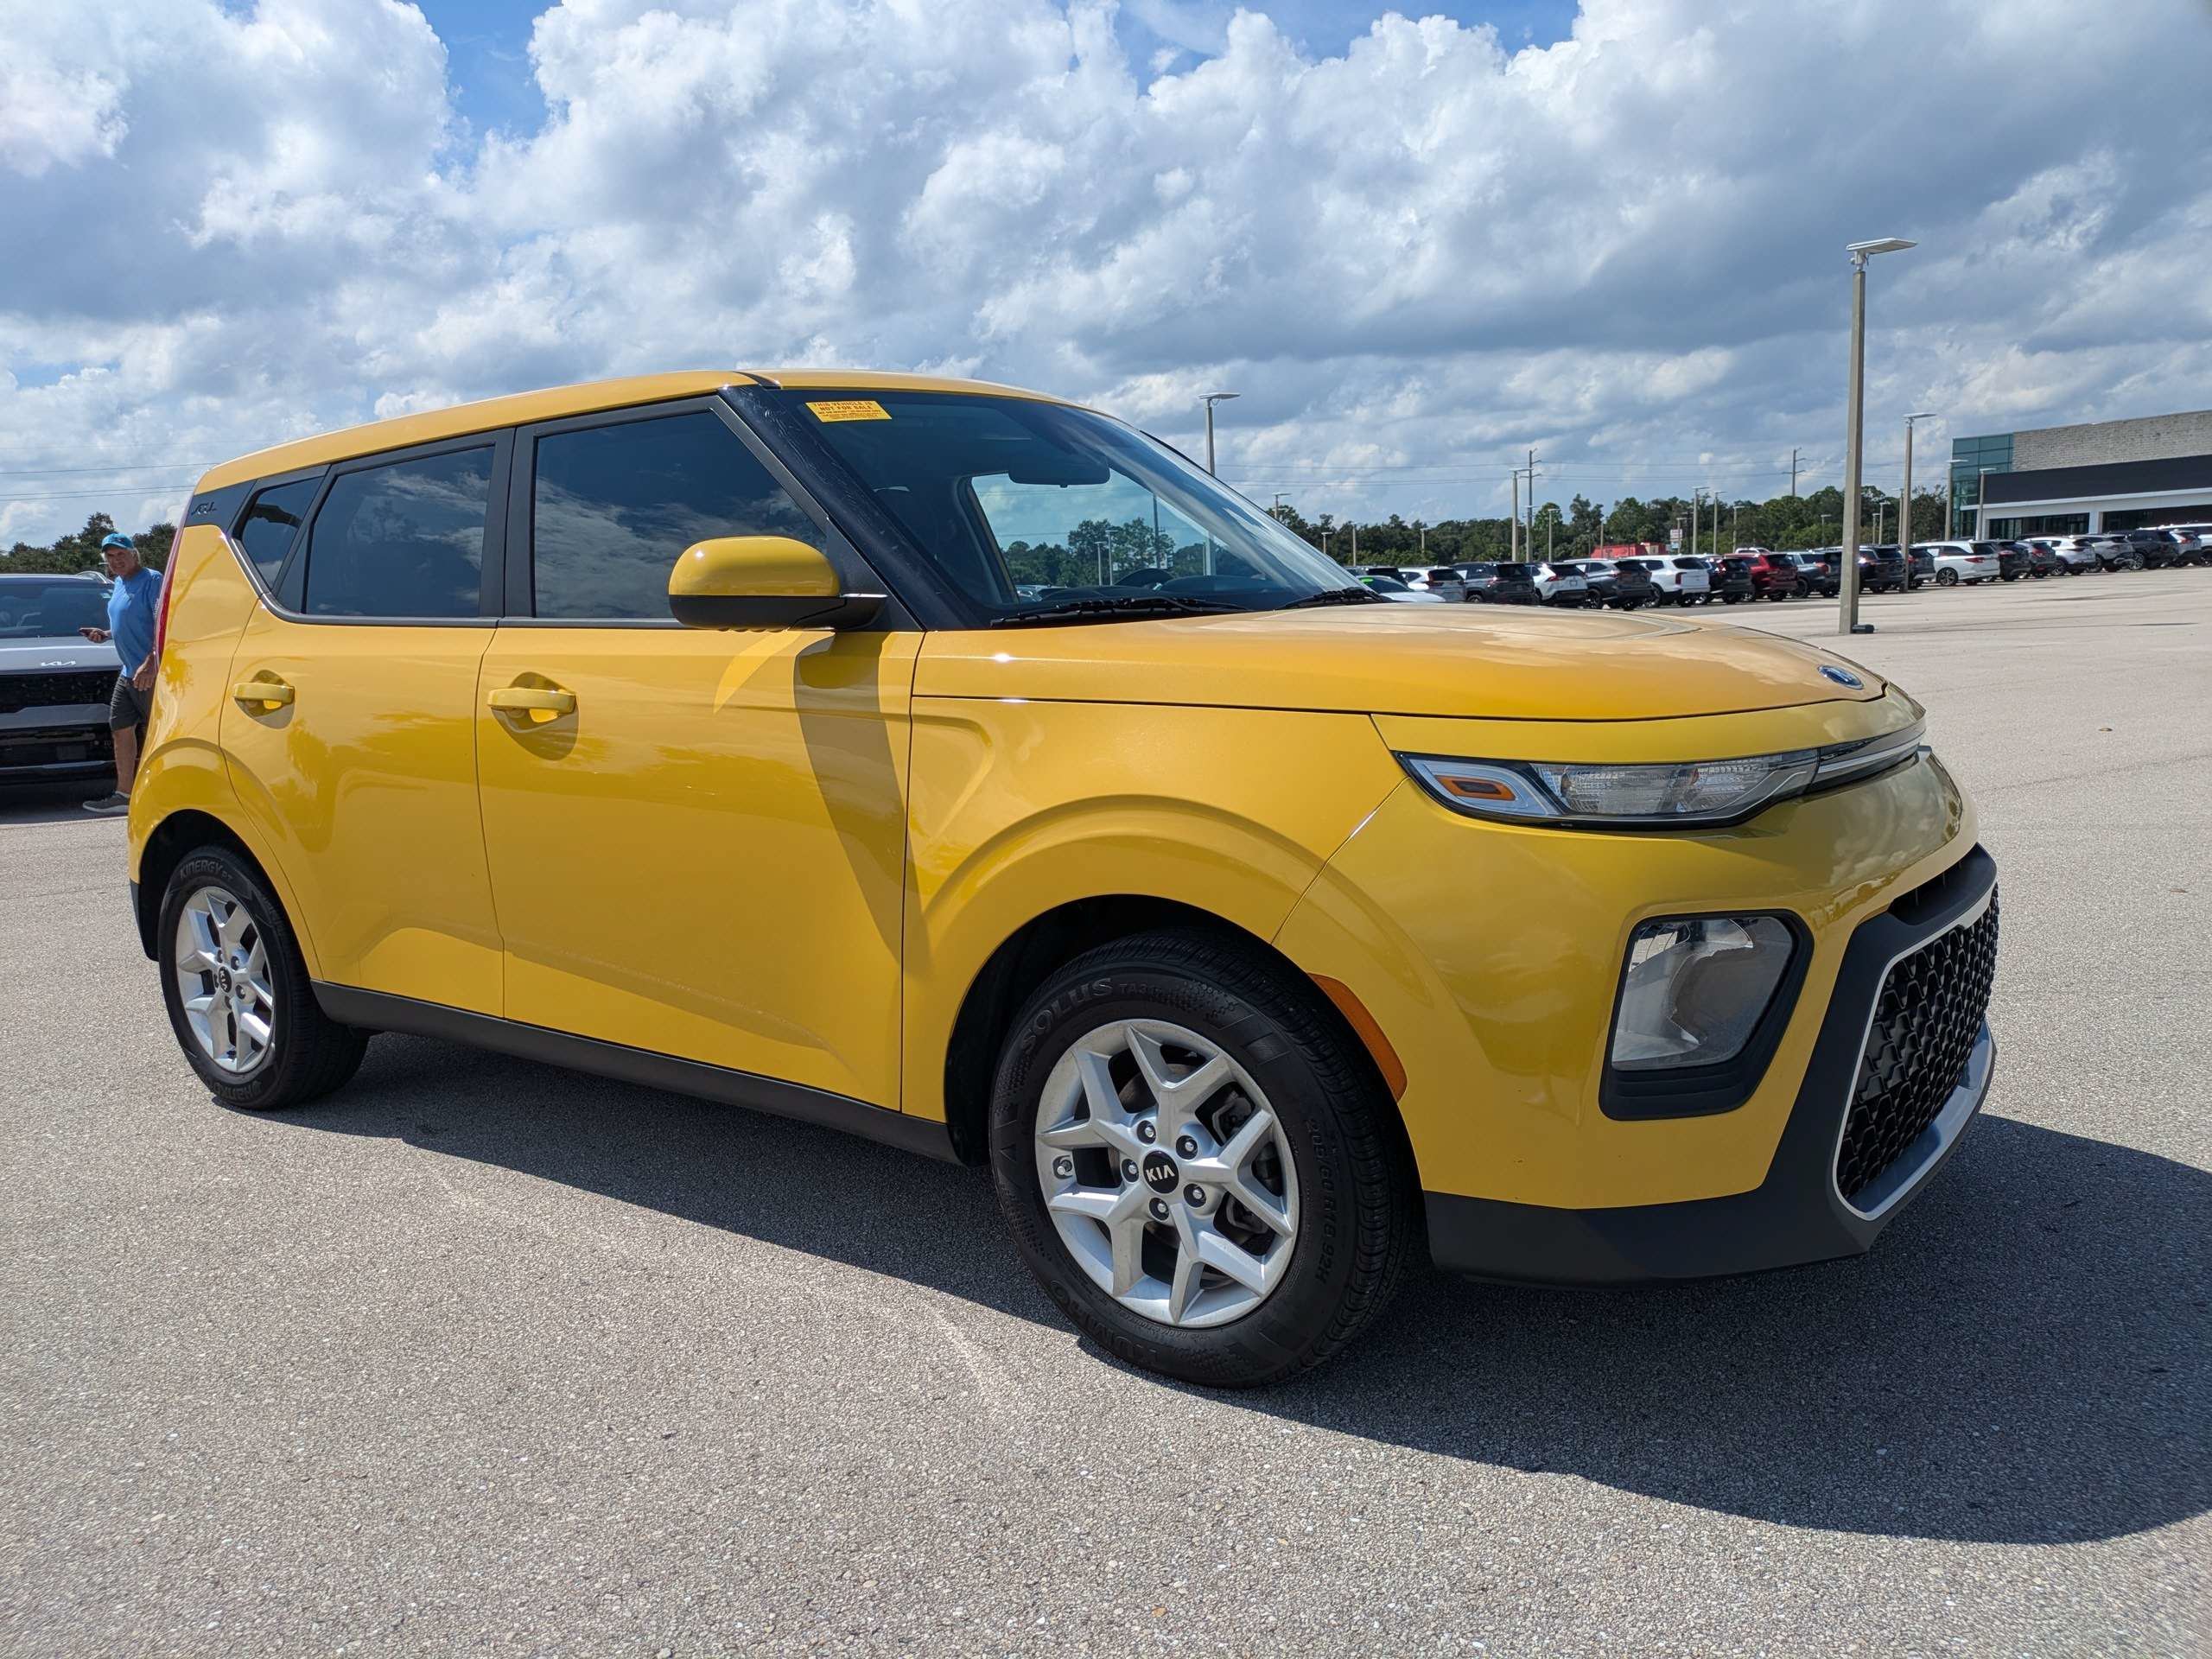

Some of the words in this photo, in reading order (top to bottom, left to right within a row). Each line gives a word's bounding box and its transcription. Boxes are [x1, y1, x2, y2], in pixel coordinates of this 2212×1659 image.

[219, 969, 228, 991] KIA
[1020, 977, 1114, 1051] SOLUS
[1145, 1164, 1176, 1182] KIA
